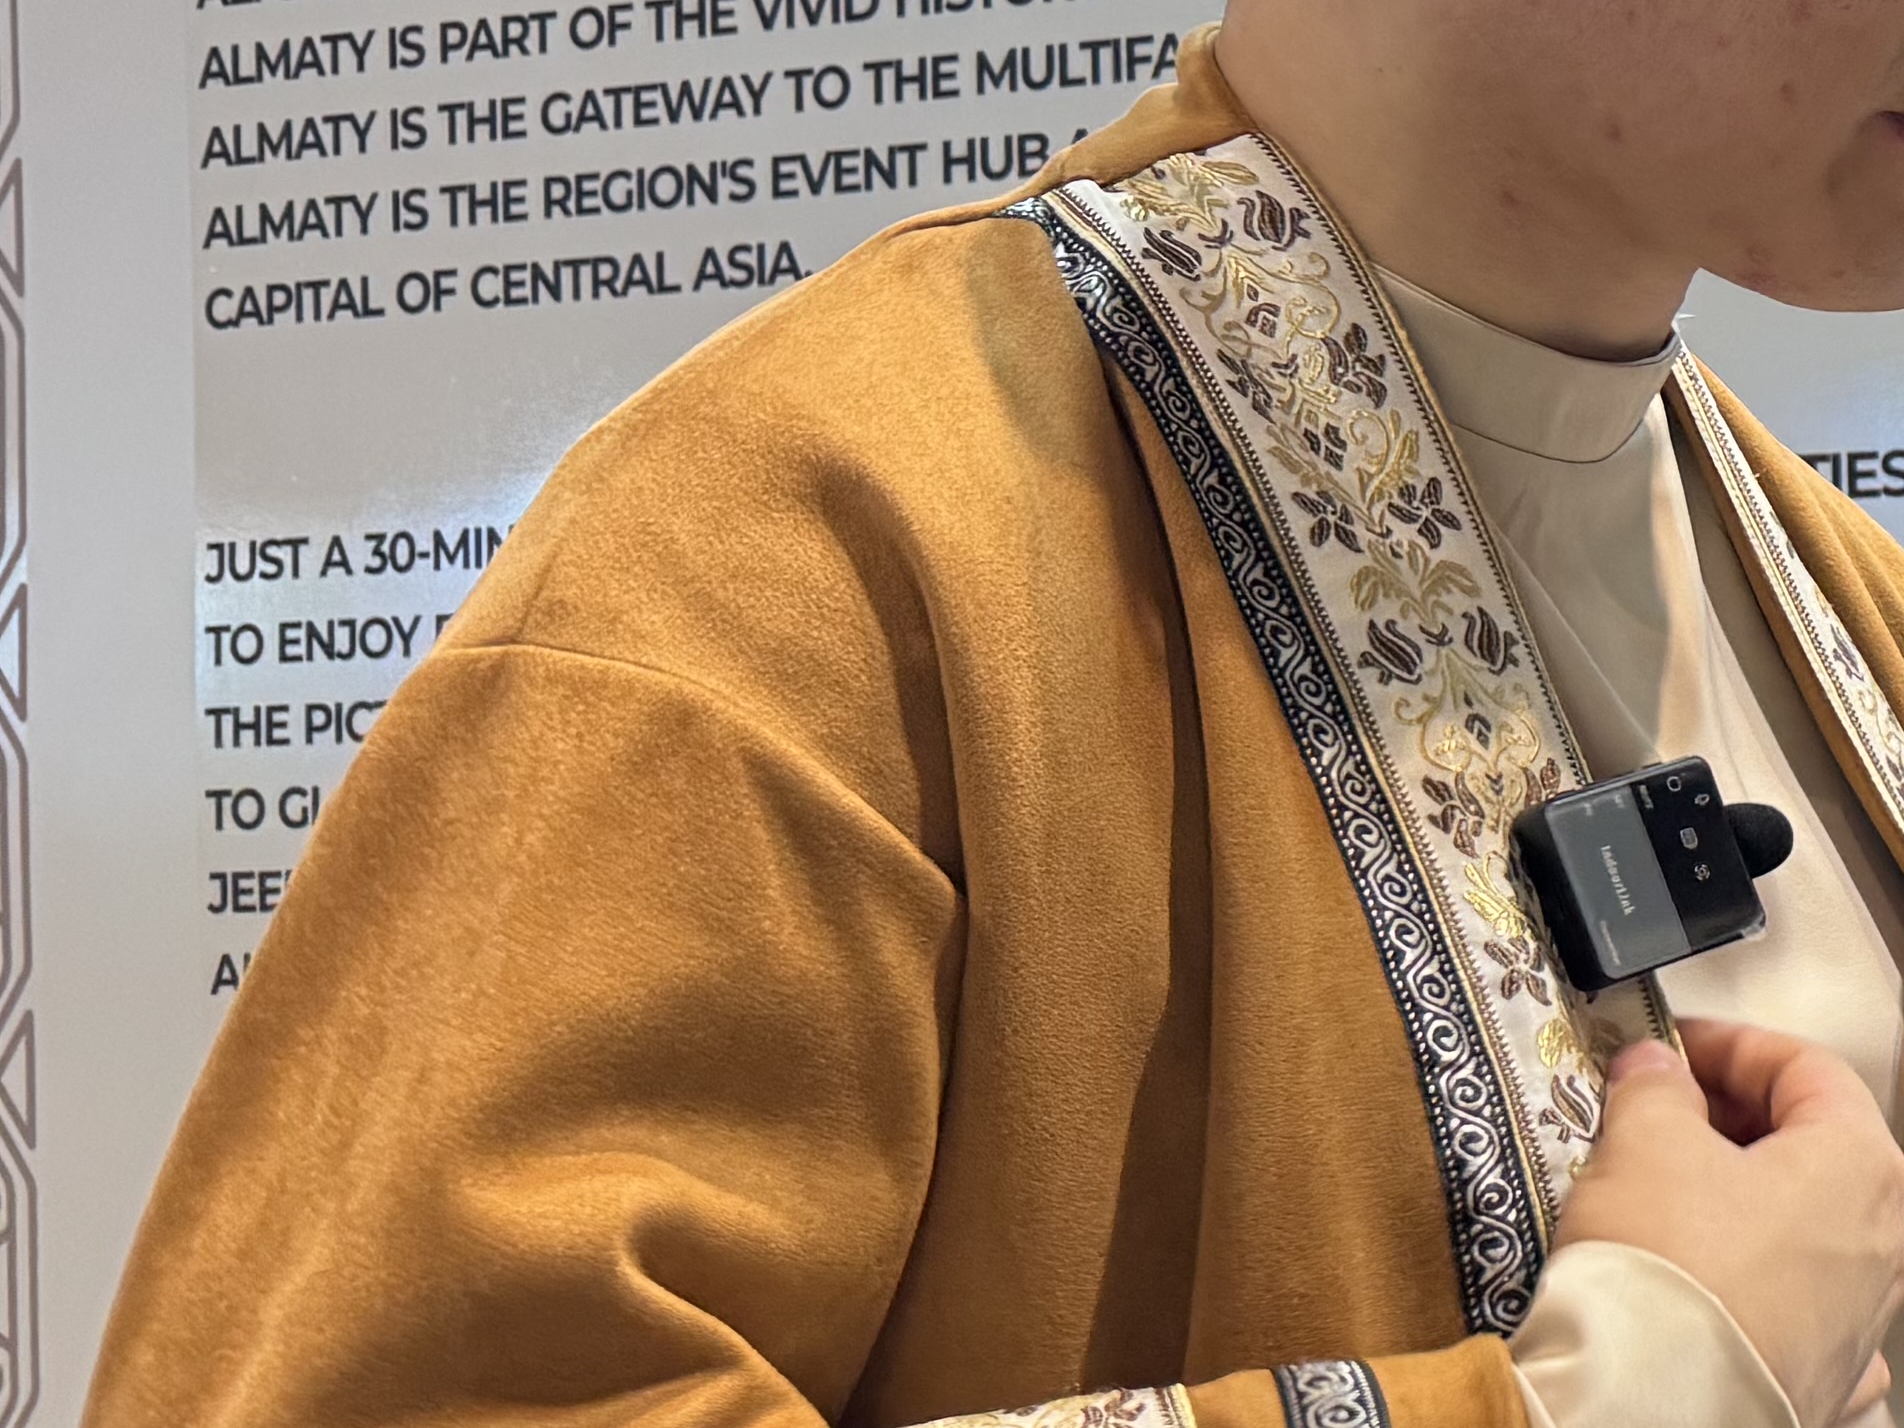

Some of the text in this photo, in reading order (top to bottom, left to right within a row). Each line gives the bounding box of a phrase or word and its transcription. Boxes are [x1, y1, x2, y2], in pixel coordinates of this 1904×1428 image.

[199, 30, 375, 89] ALMATY
[388, 25, 426, 69] IS
[440, 7, 557, 64] PART
[569, 3, 633, 50] OF
[201, 111, 376, 169] ALMATY
[390, 106, 427, 150] IS
[437, 96, 527, 145] THE
[541, 72, 773, 135] GATEWAY
[783, 65, 850, 112] TO
[863, 54, 960, 105] THE
[203, 133, 1049, 249] ALMATY IS THE REGION'S EVENT HUB
[205, 240, 814, 330] CAPITAL OF CENTRAL ASIA.
[205, 537, 309, 583] JUST
[320, 535, 353, 577] A
[205, 624, 264, 666] TO
[279, 616, 420, 663] ENJOY
[205, 705, 290, 748] THE
[205, 788, 265, 831] TO
[207, 869, 294, 914] JEE
